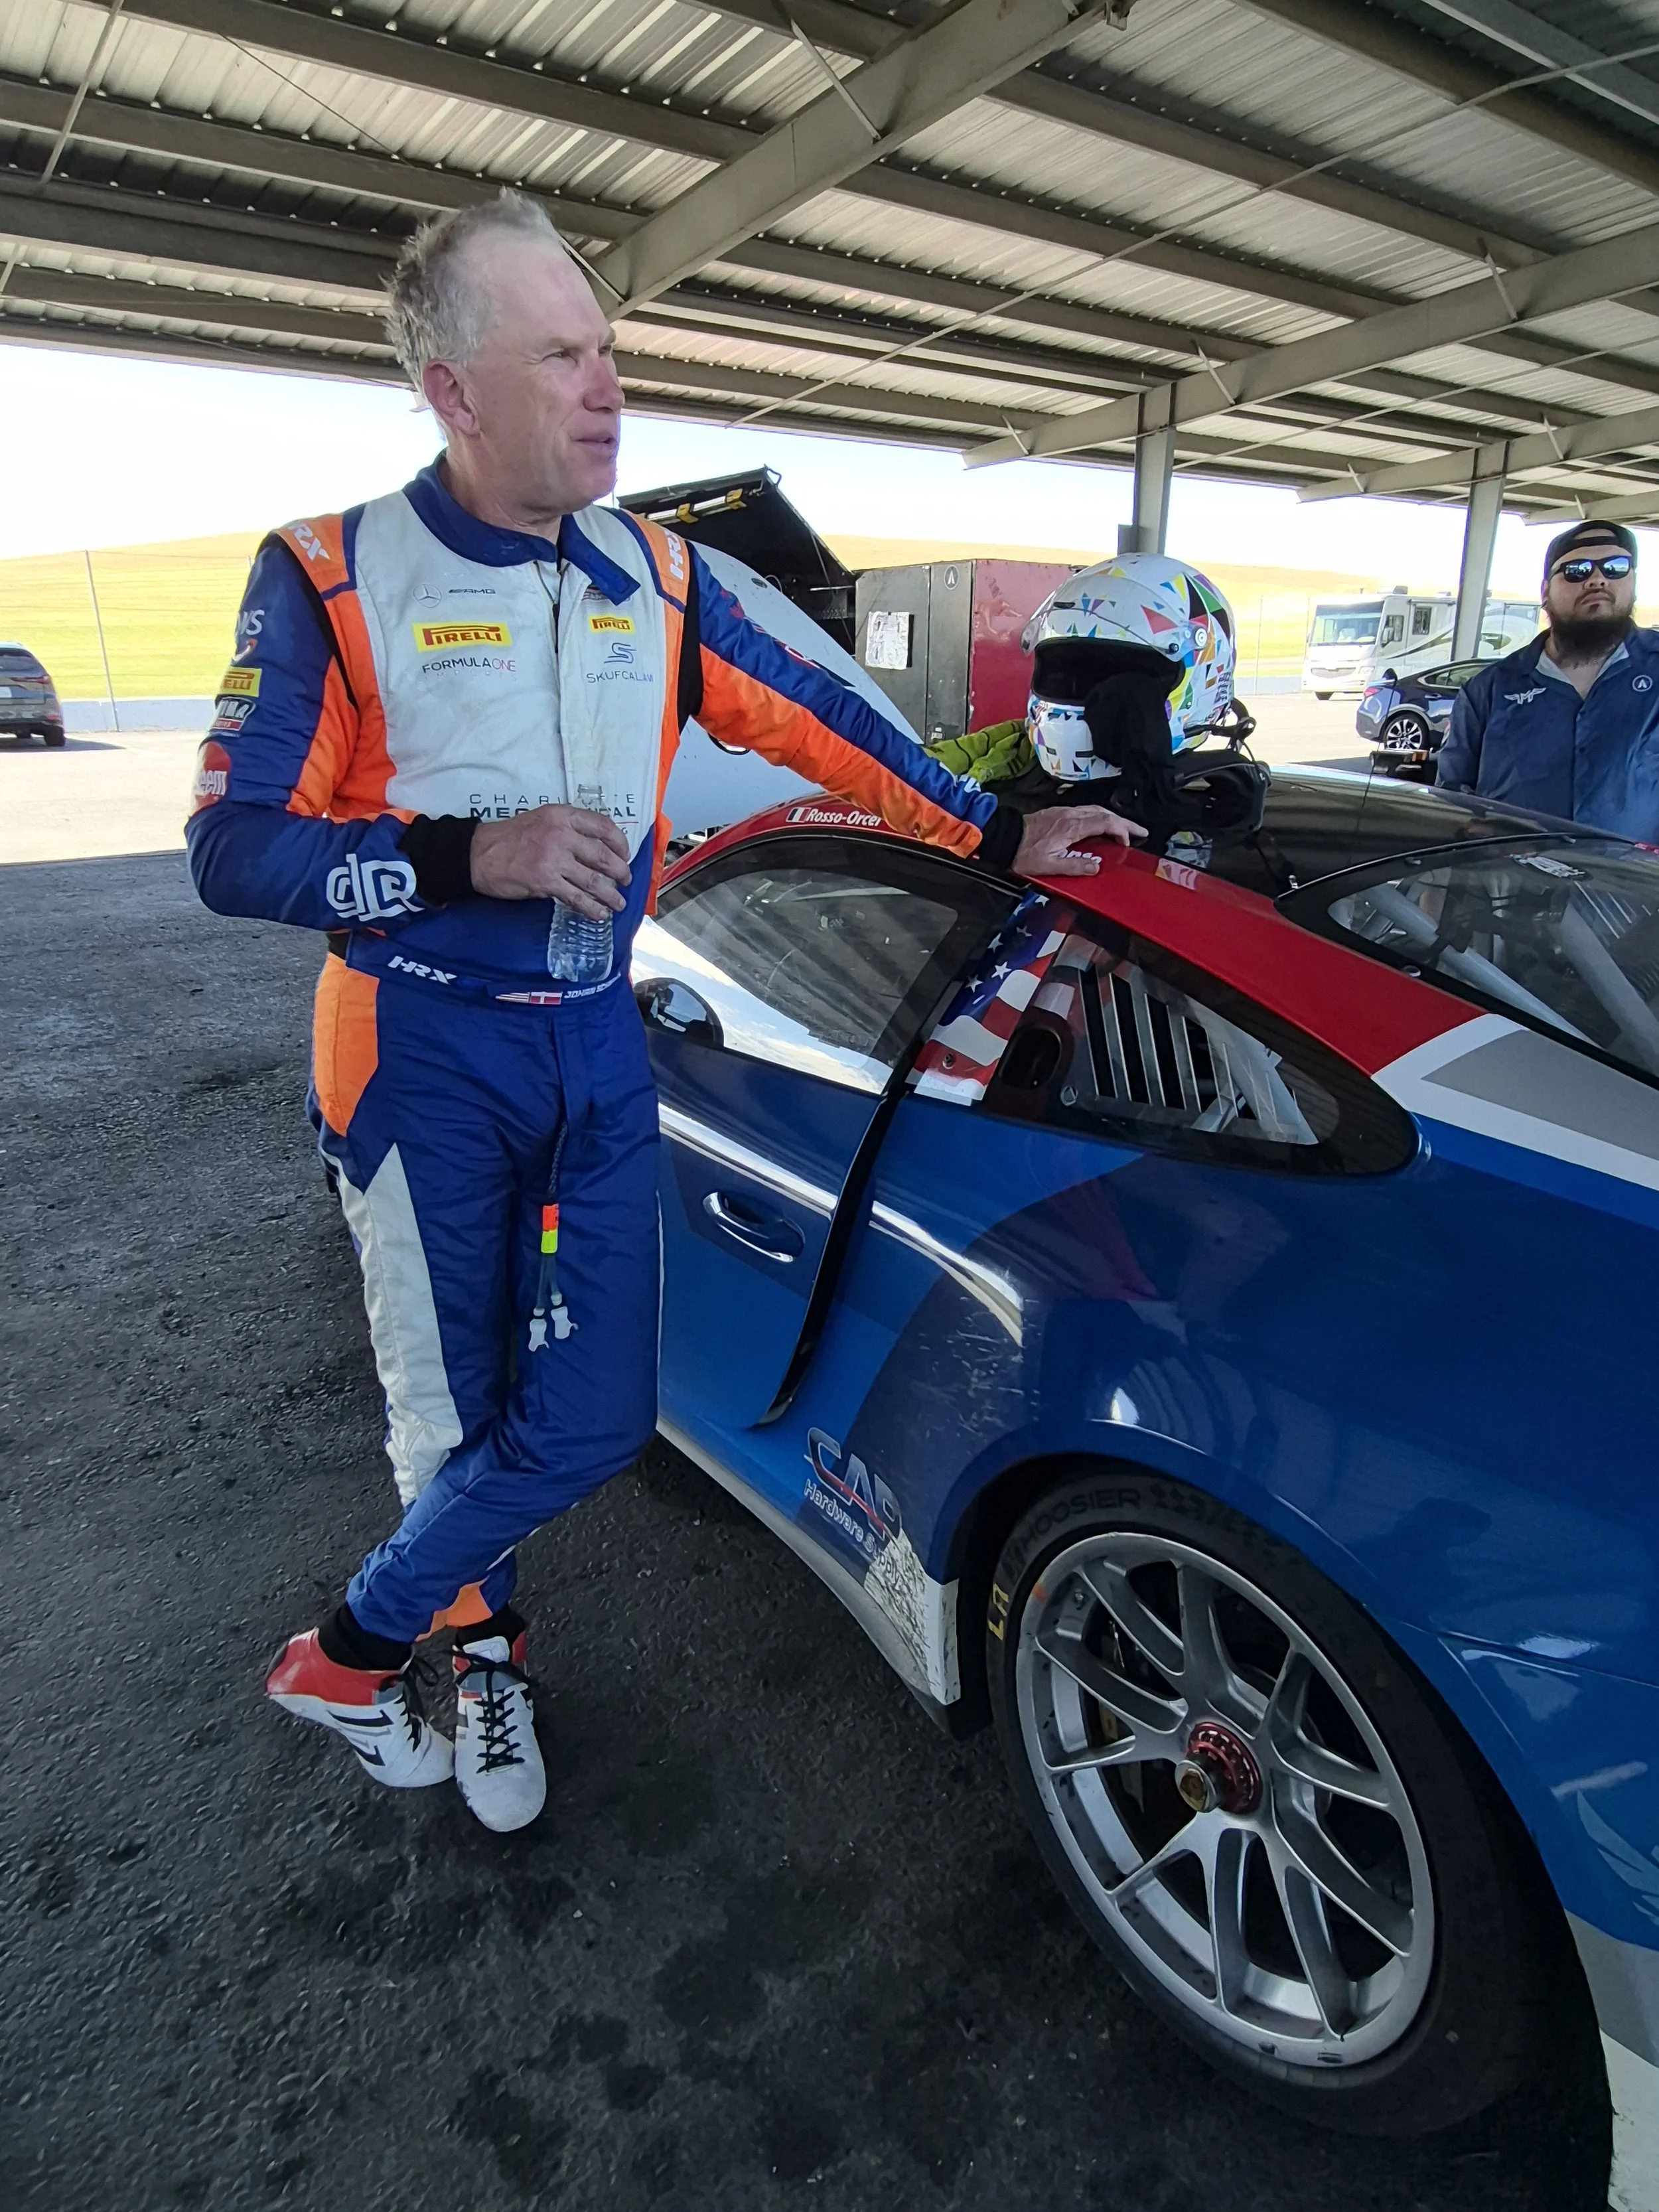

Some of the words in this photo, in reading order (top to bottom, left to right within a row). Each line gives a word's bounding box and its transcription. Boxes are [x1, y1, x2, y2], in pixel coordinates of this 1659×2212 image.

[423, 625, 502, 646] PIRELLI
[592, 617, 630, 630] PIRELLI
[388, 956, 457, 985] HRX
[808, 1427, 902, 1542] CAP
[804, 1479, 864, 1542] Hardware
[1022, 1488, 1141, 1554] HOOSIER
